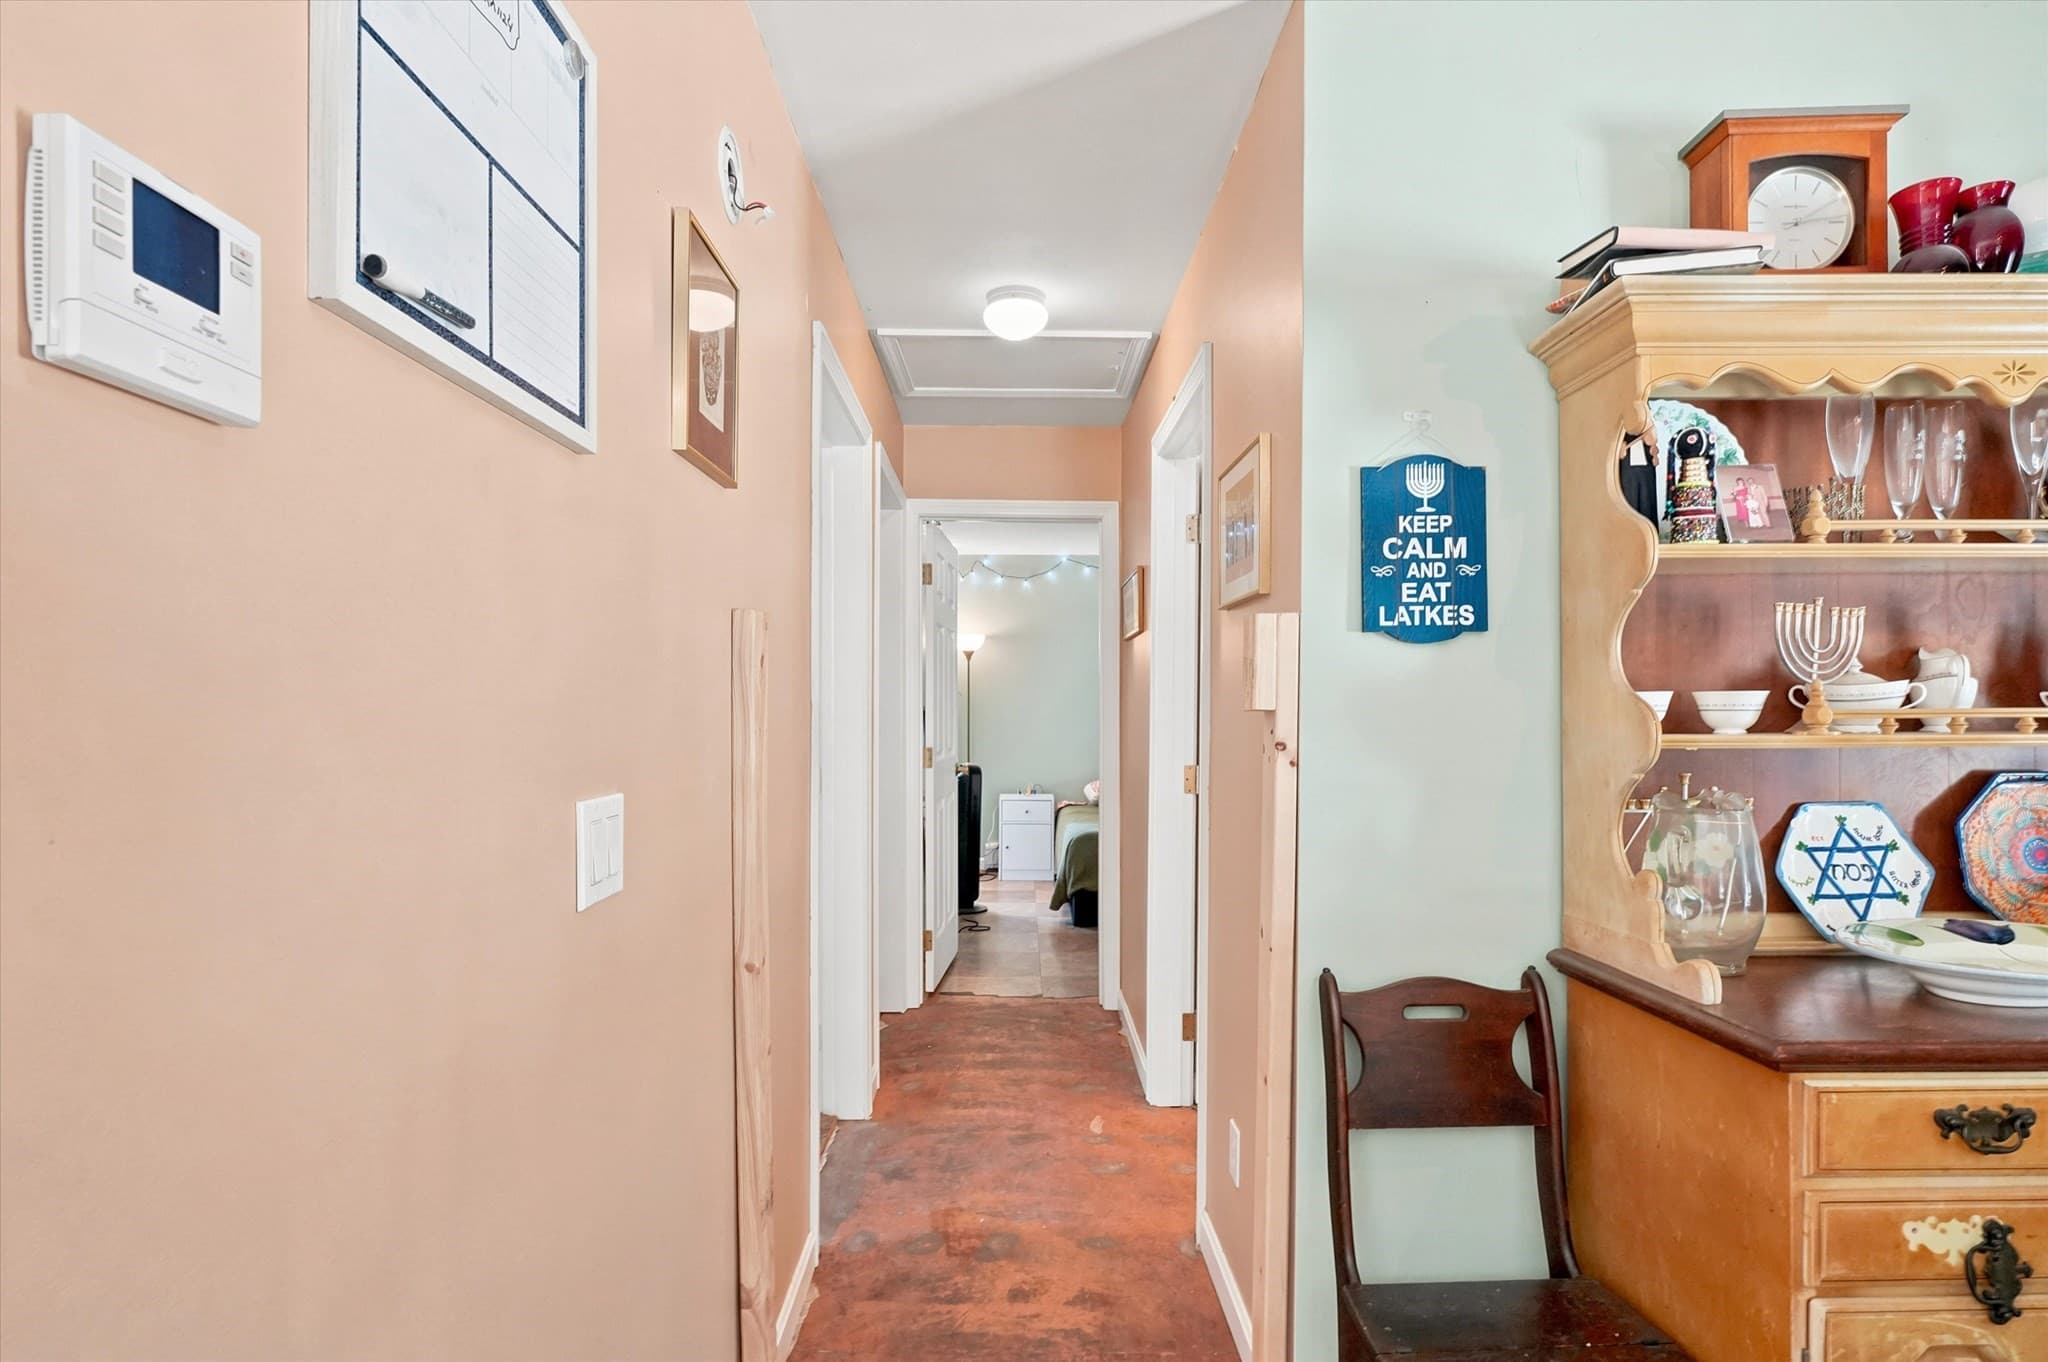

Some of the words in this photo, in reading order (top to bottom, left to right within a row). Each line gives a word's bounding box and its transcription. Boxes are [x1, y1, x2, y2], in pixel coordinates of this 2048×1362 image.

[1398, 515, 1453, 533] KEEP
[1382, 536, 1468, 560] CALM
[1406, 562, 1447, 578] AND
[1401, 581, 1452, 603] EAT
[1379, 604, 1475, 627] LATKES
[1831, 863, 1875, 882] פסח
